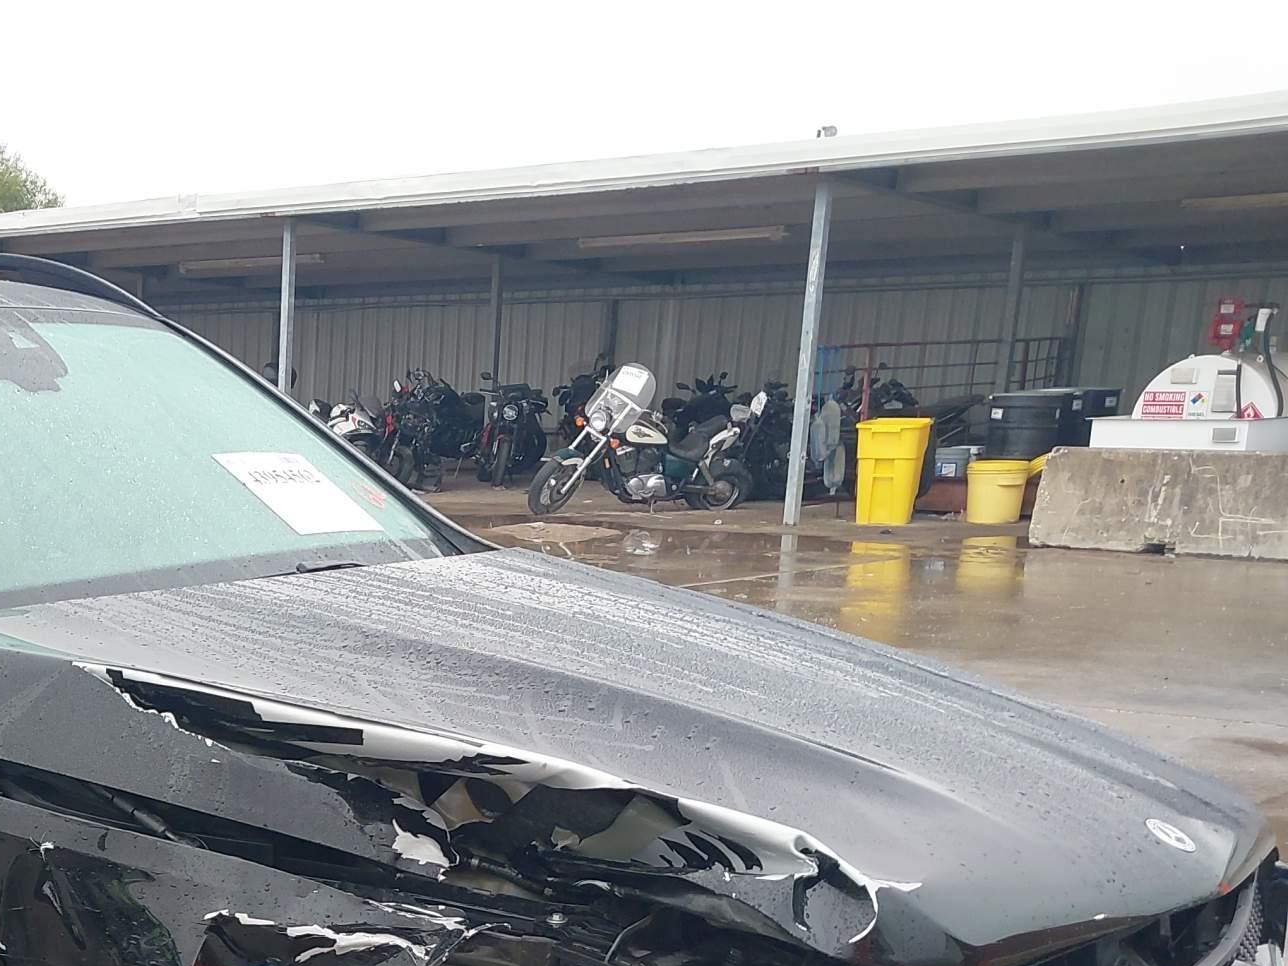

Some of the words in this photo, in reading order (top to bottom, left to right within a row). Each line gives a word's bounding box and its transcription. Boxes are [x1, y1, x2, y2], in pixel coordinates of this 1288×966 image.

[1144, 392, 1153, 402] NO
[1154, 392, 1185, 402] SMOKING
[1142, 405, 1183, 414] COMBUSTIBLE
